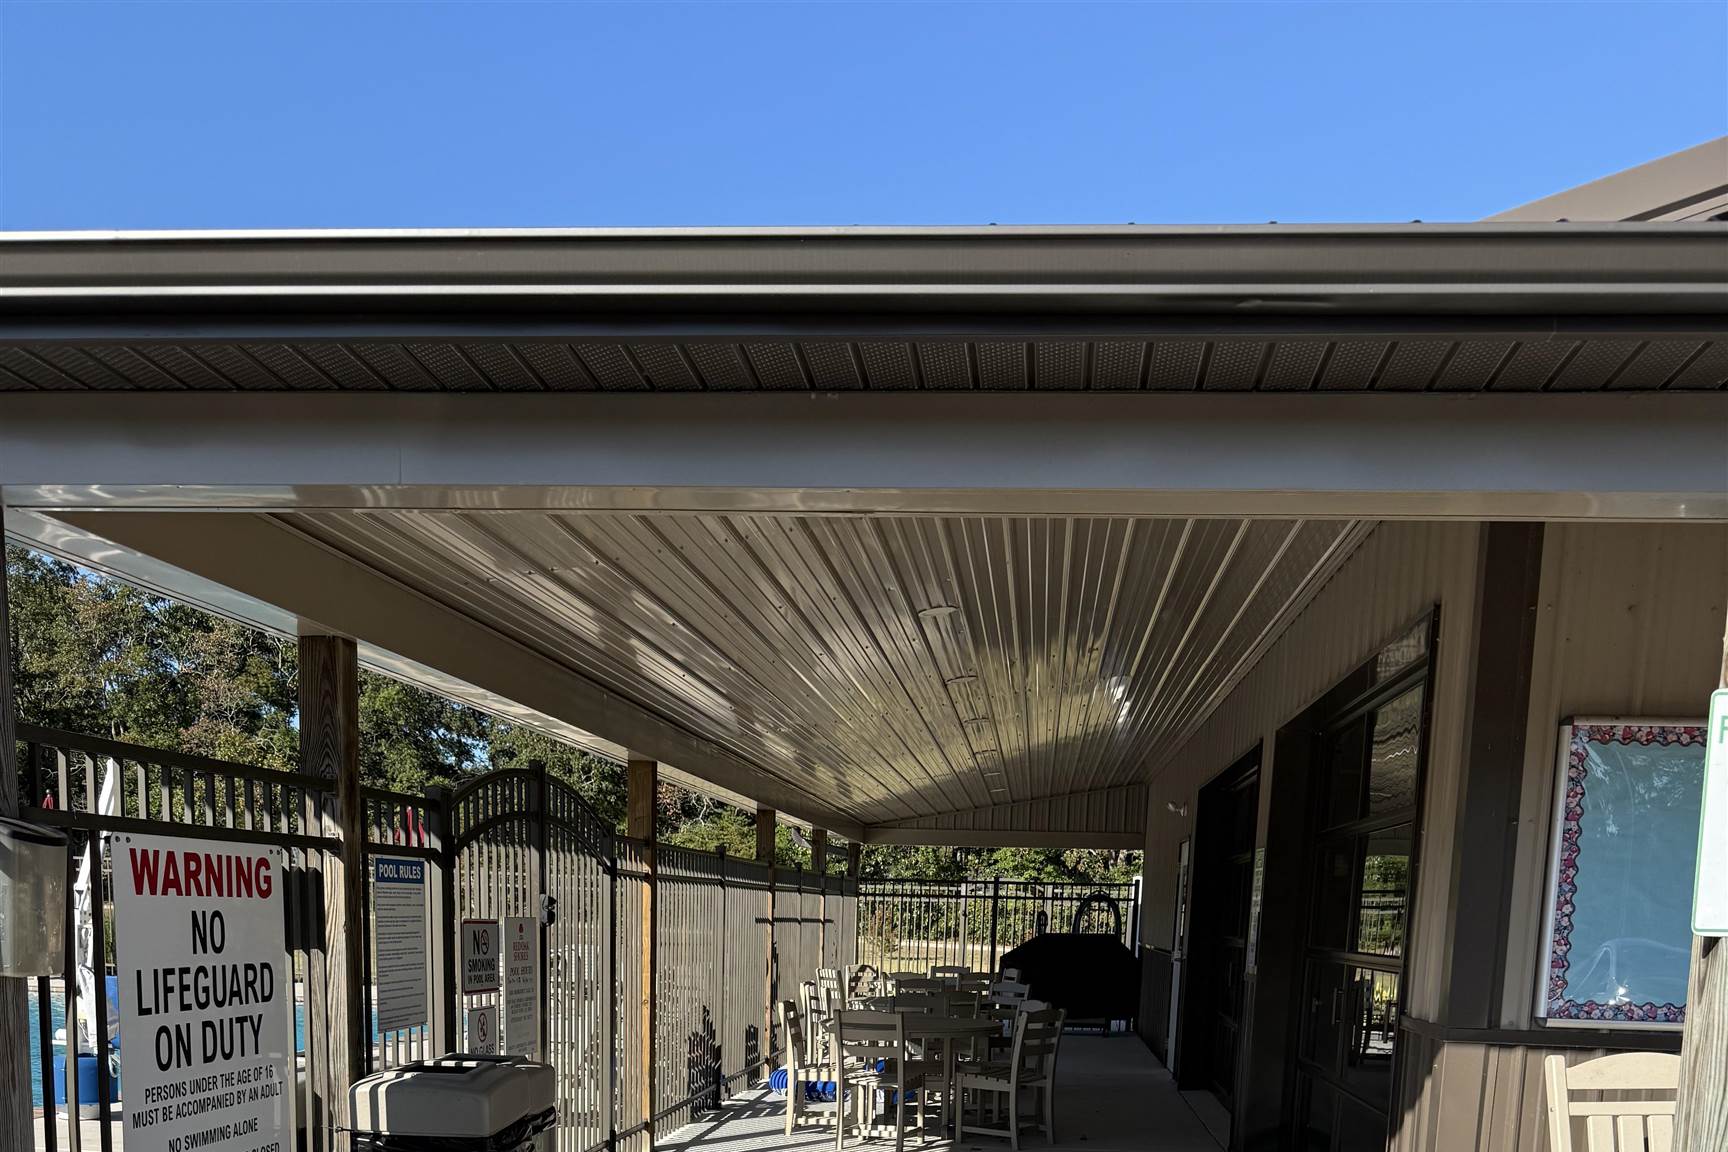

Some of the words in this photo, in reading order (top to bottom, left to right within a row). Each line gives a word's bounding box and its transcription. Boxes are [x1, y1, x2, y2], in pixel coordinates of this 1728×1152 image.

[129, 848, 273, 899] WARNING
[379, 864, 398, 878] POOL
[399, 865, 421, 879] RULES
[191, 910, 225, 954] NO
[468, 958, 495, 973] SMOKING
[473, 974, 483, 984] POOL
[485, 973, 495, 983] AREA
[136, 962, 274, 1016] LIFEGUARD
[155, 1023, 192, 1072] ON
[202, 1014, 263, 1064] DUTY
[132, 1108, 159, 1129] MUST
[162, 1105, 173, 1122] BE
[175, 1092, 235, 1119] ACCOMPANIED
[236, 1090, 247, 1105] BY
[248, 1086, 259, 1102] AN
[260, 1081, 283, 1099] ADULT
[145, 1081, 187, 1104] PERSONS
[189, 1075, 218, 1095] UNDER
[220, 1072, 235, 1088] THE
[237, 1069, 251, 1085] AGE
[253, 1067, 263, 1082] OF
[265, 1065, 273, 1079] 16
[184, 1124, 231, 1150] SWIMMING
[233, 1118, 258, 1138] ALONE
